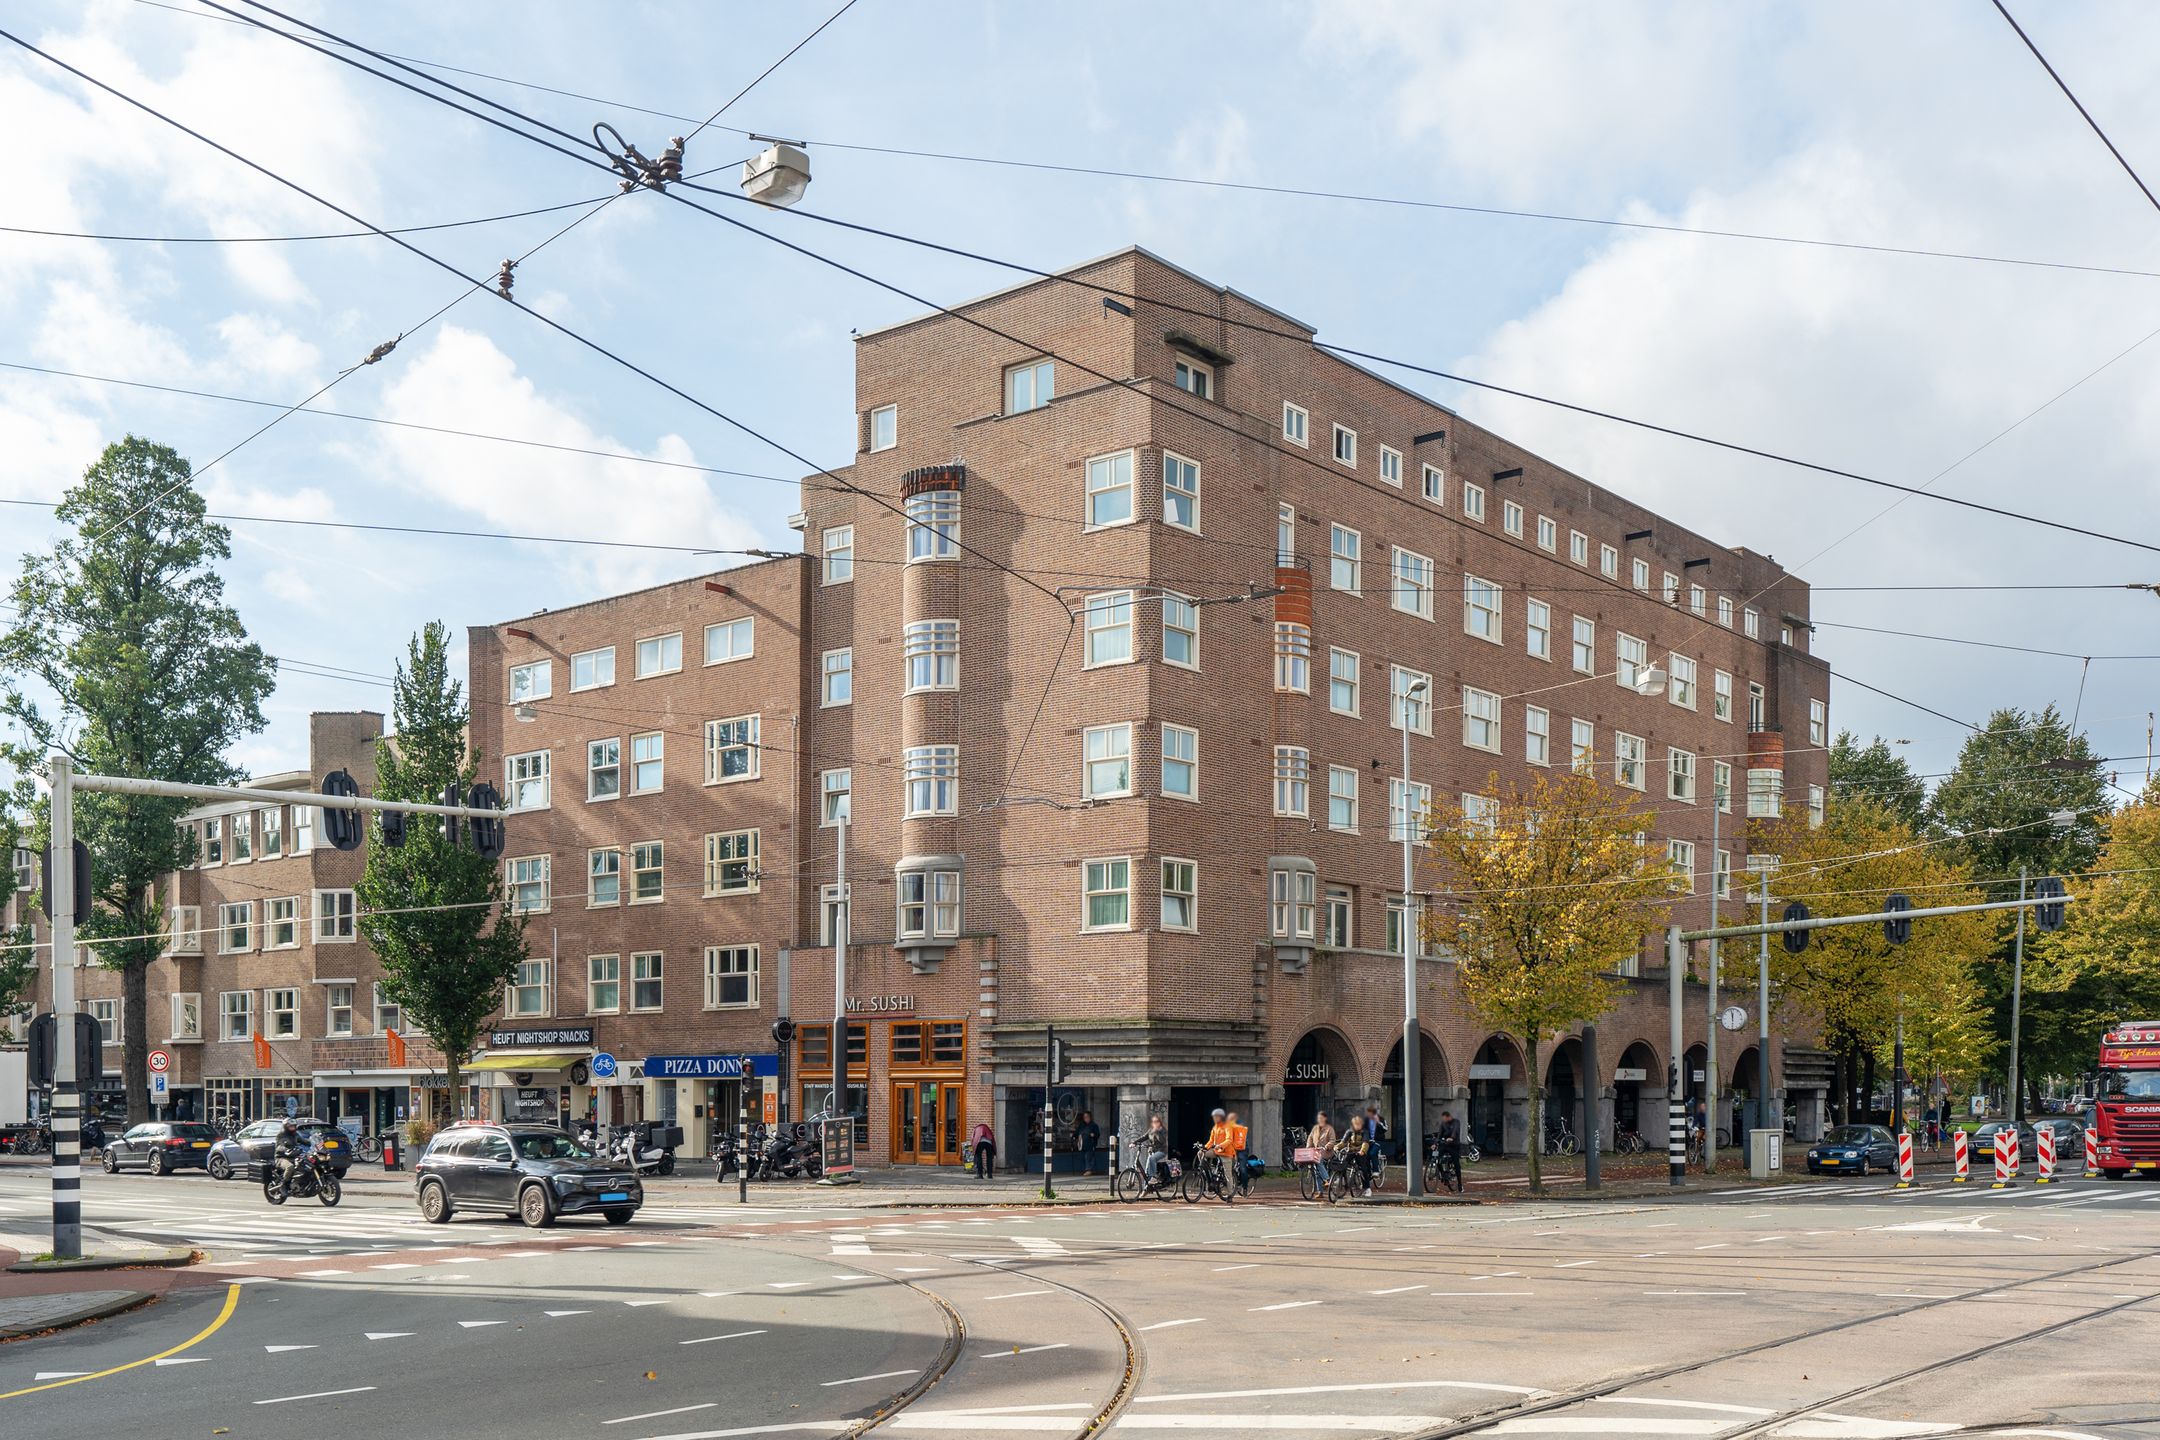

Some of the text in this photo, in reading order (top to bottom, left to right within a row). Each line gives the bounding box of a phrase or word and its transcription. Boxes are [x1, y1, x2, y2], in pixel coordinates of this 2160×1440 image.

[845, 995, 914, 1012] Mr. SUSHI
[492, 1030, 590, 1045] HEUFT NIGHTSHOP SNACKS
[153, 1057, 166, 1066] 30
[664, 1059, 743, 1074] PIZZA DONN
[1296, 1063, 1329, 1079] SUSHI
[419, 1075, 449, 1089] blokke
[514, 1099, 545, 1107] NIGHTSHOP
